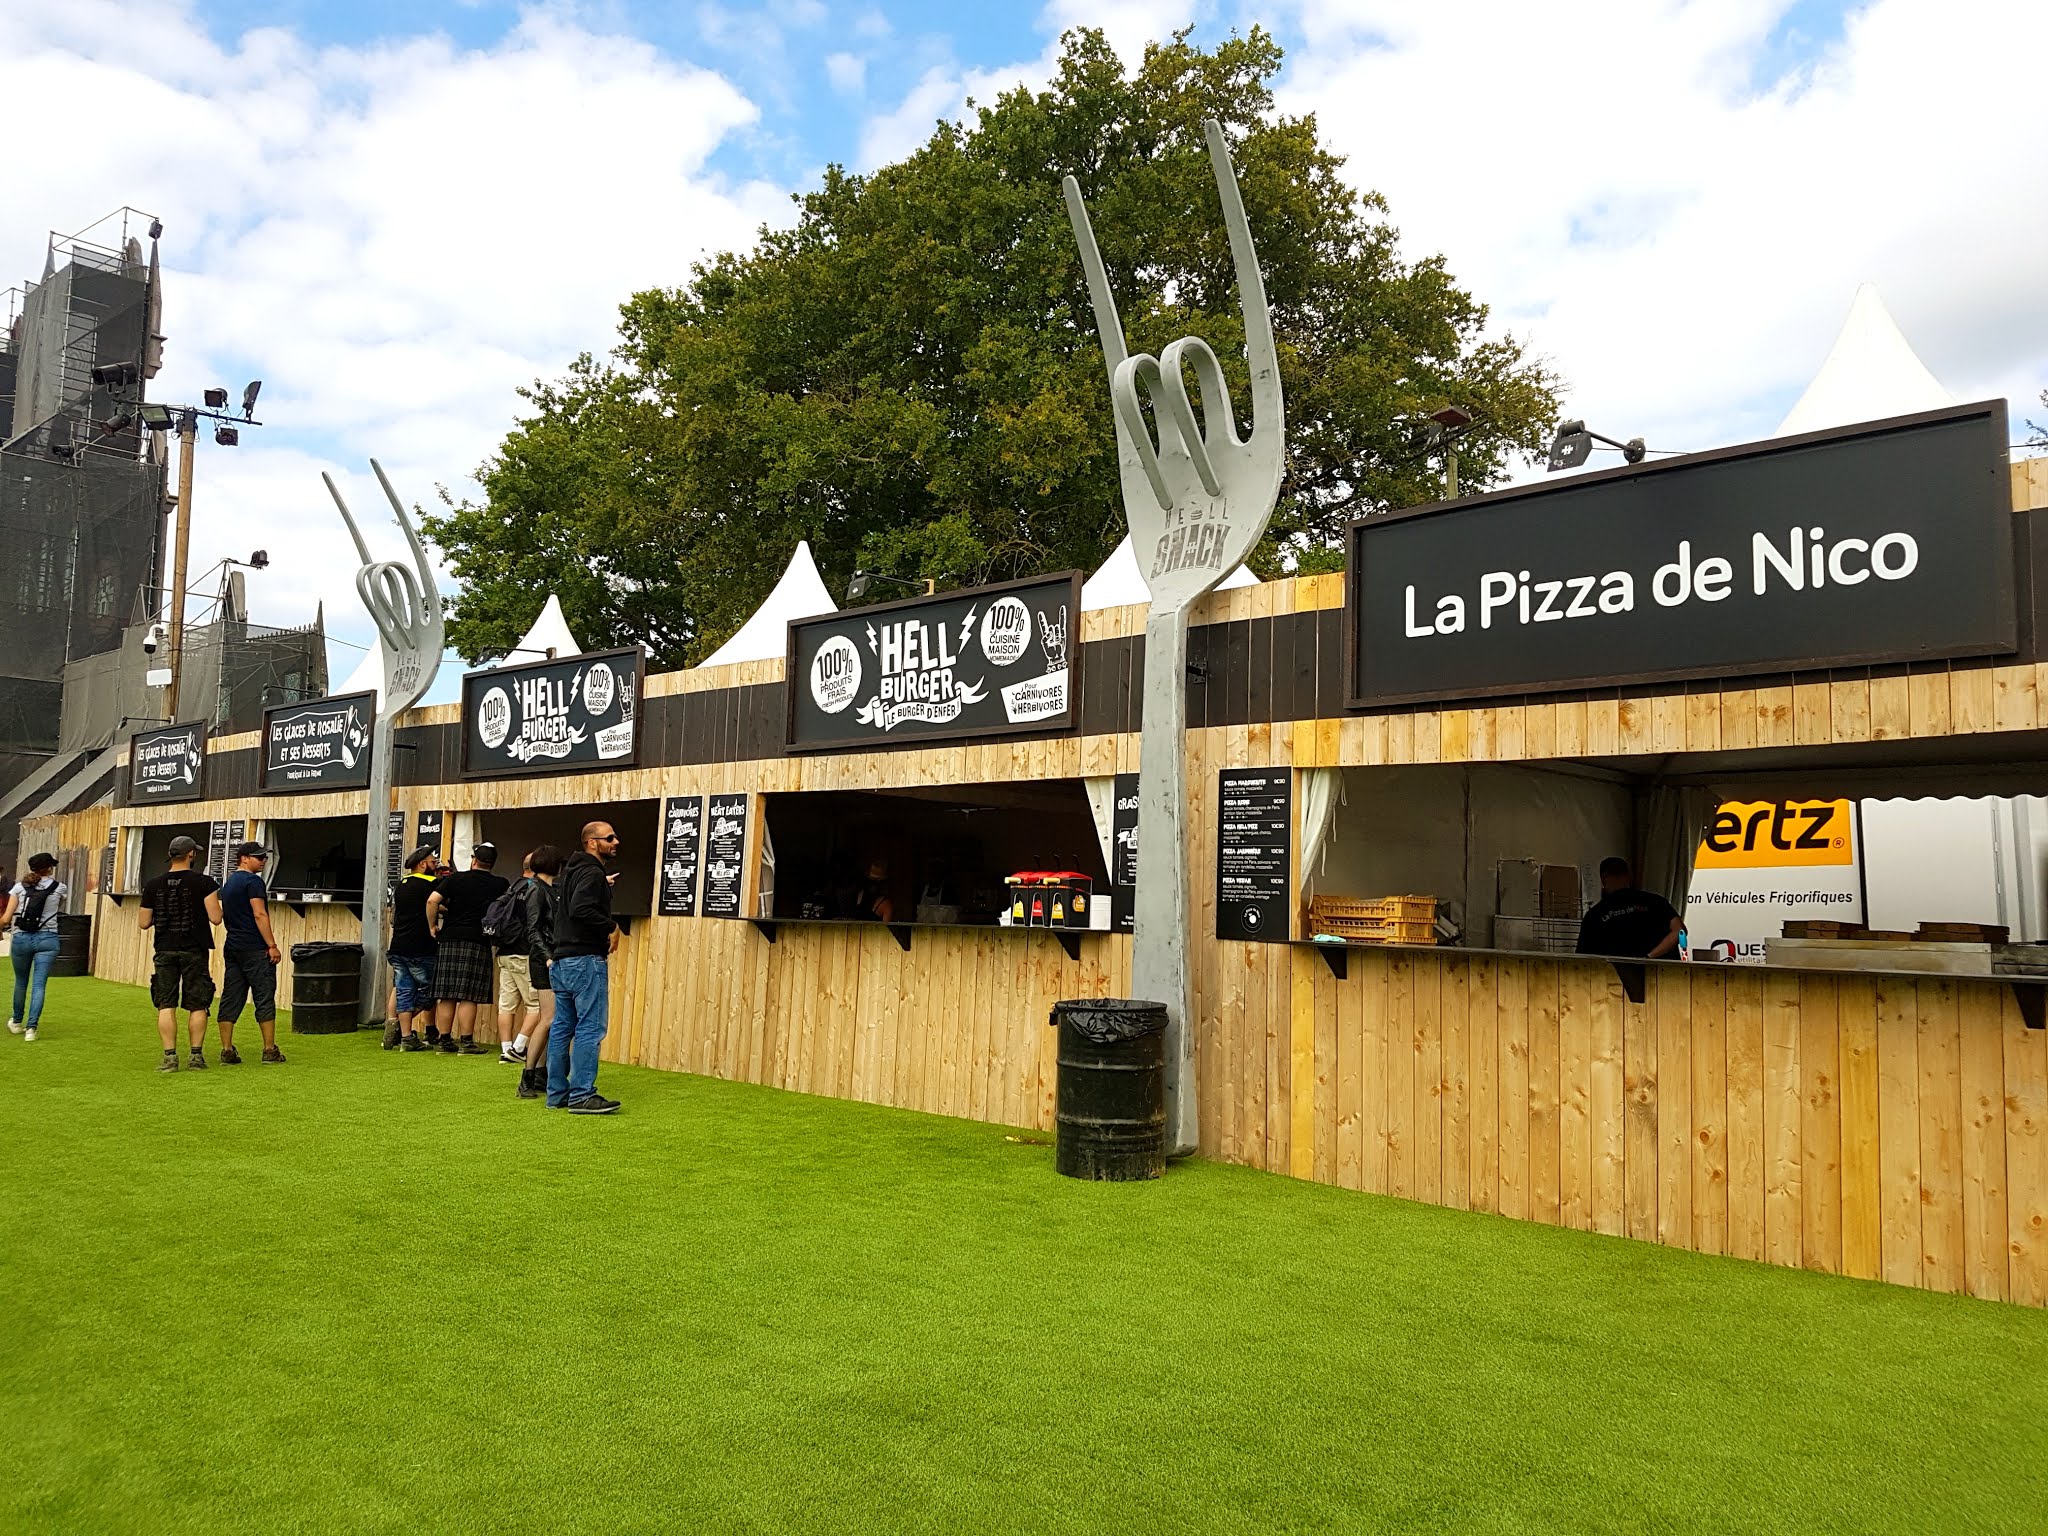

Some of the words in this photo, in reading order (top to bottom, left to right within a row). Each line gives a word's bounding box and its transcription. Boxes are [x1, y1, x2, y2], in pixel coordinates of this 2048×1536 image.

[1150, 522, 1231, 580] SNACK
[1404, 584, 1465, 638] La
[1480, 568, 1634, 630] Pizza
[1652, 540, 1732, 607] de
[1752, 526, 1919, 595] Nico
[991, 605, 1024, 632] 100%
[881, 620, 956, 676] HELL
[990, 634, 1020, 644] CUISINE
[988, 645, 1020, 654] MAISON
[817, 648, 853, 682] 100%
[590, 670, 610, 690] 100%
[820, 676, 852, 694] PRODUITS
[880, 668, 954, 702] BURGER
[522, 676, 569, 720] HELL
[827, 688, 846, 700] FRAIS
[1015, 686, 1062, 701] CARNIVORES
[483, 695, 505, 724] 100%
[887, 712, 895, 724] LE
[898, 704, 924, 717] BURGER
[1018, 698, 1064, 714] HERBIVORES
[273, 726, 282, 742] LES
[284, 723, 306, 743] GLACES
[308, 720, 316, 737] DE
[317, 714, 344, 738] ROSALIE
[484, 718, 505, 733] PRODUITS
[488, 728, 501, 738] FRAIS
[522, 716, 567, 742] BURGER
[603, 732, 631, 742] CARNIVORES
[161, 743, 167, 757] DE
[281, 748, 288, 761] ET
[290, 746, 300, 760] SES
[302, 742, 331, 759] DESSERTS
[526, 748, 532, 758] LE
[532, 743, 549, 752] BURGER
[143, 766, 148, 777] ET
[157, 762, 177, 776] DESSERTS
[1706, 800, 1835, 852] ertz
[1688, 895, 1701, 904] on
[1706, 891, 1765, 904] Véhicules
[1770, 890, 1853, 906] Frigorifiques
